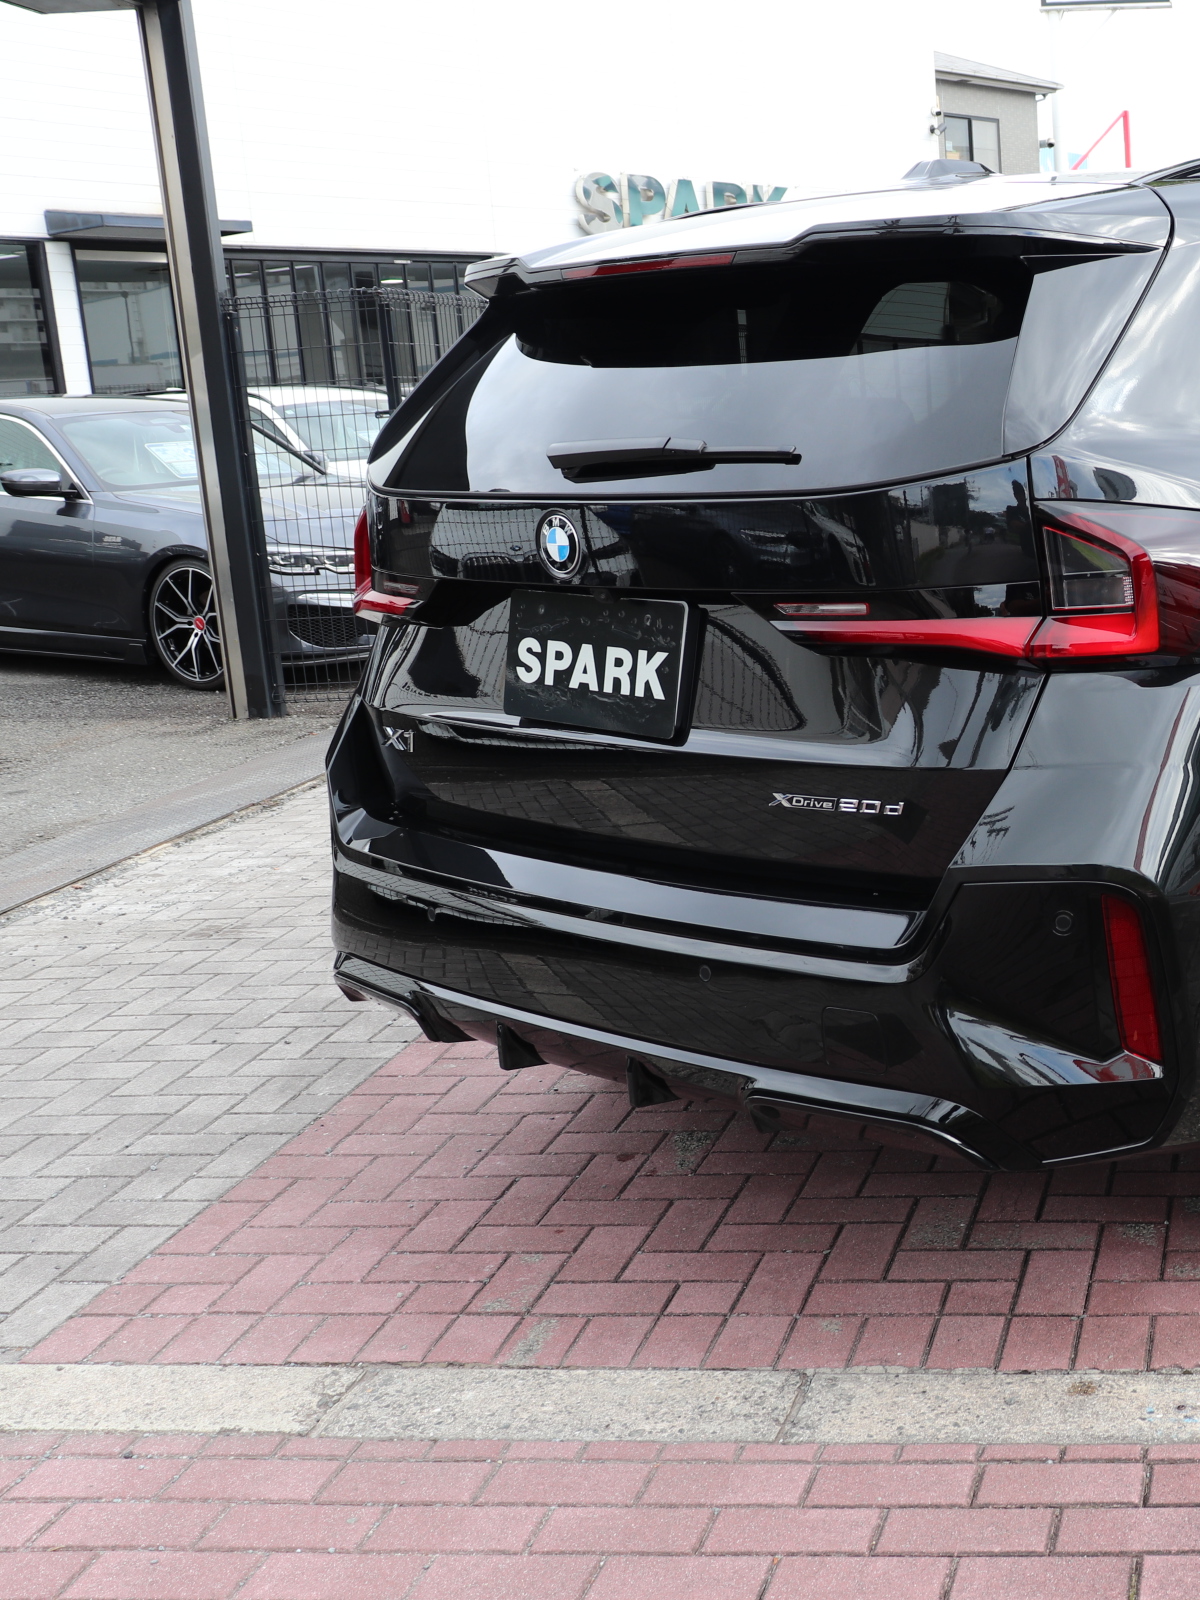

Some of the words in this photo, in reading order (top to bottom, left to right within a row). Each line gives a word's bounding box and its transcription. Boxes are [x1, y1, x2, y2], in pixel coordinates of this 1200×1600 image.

[542, 517, 573, 536] BMW
[515, 637, 669, 700] SPARK
[381, 725, 415, 752] X1
